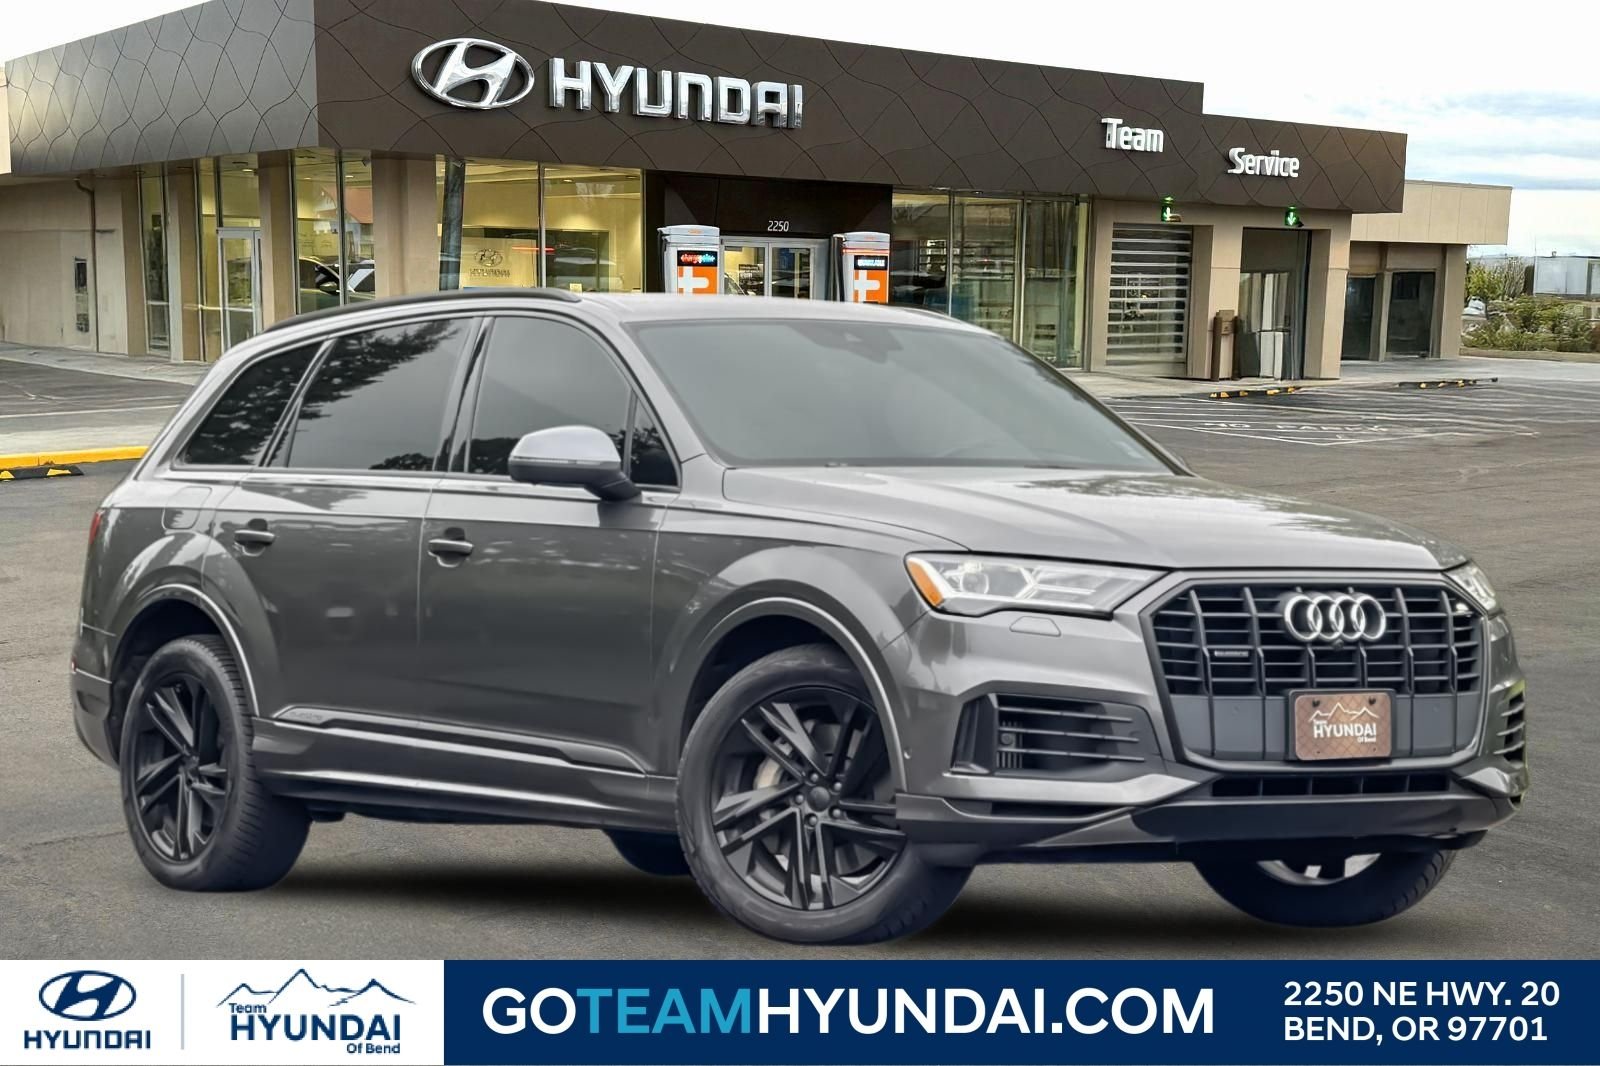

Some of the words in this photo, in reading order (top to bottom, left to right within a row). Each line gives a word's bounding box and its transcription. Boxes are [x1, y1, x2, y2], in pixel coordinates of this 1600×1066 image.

[548, 57, 803, 129] HYUNDAI
[1101, 117, 1164, 153] Team
[1227, 147, 1300, 178] Service
[767, 220, 790, 232] 2250
[1313, 722, 1377, 739] HYUNDAI
